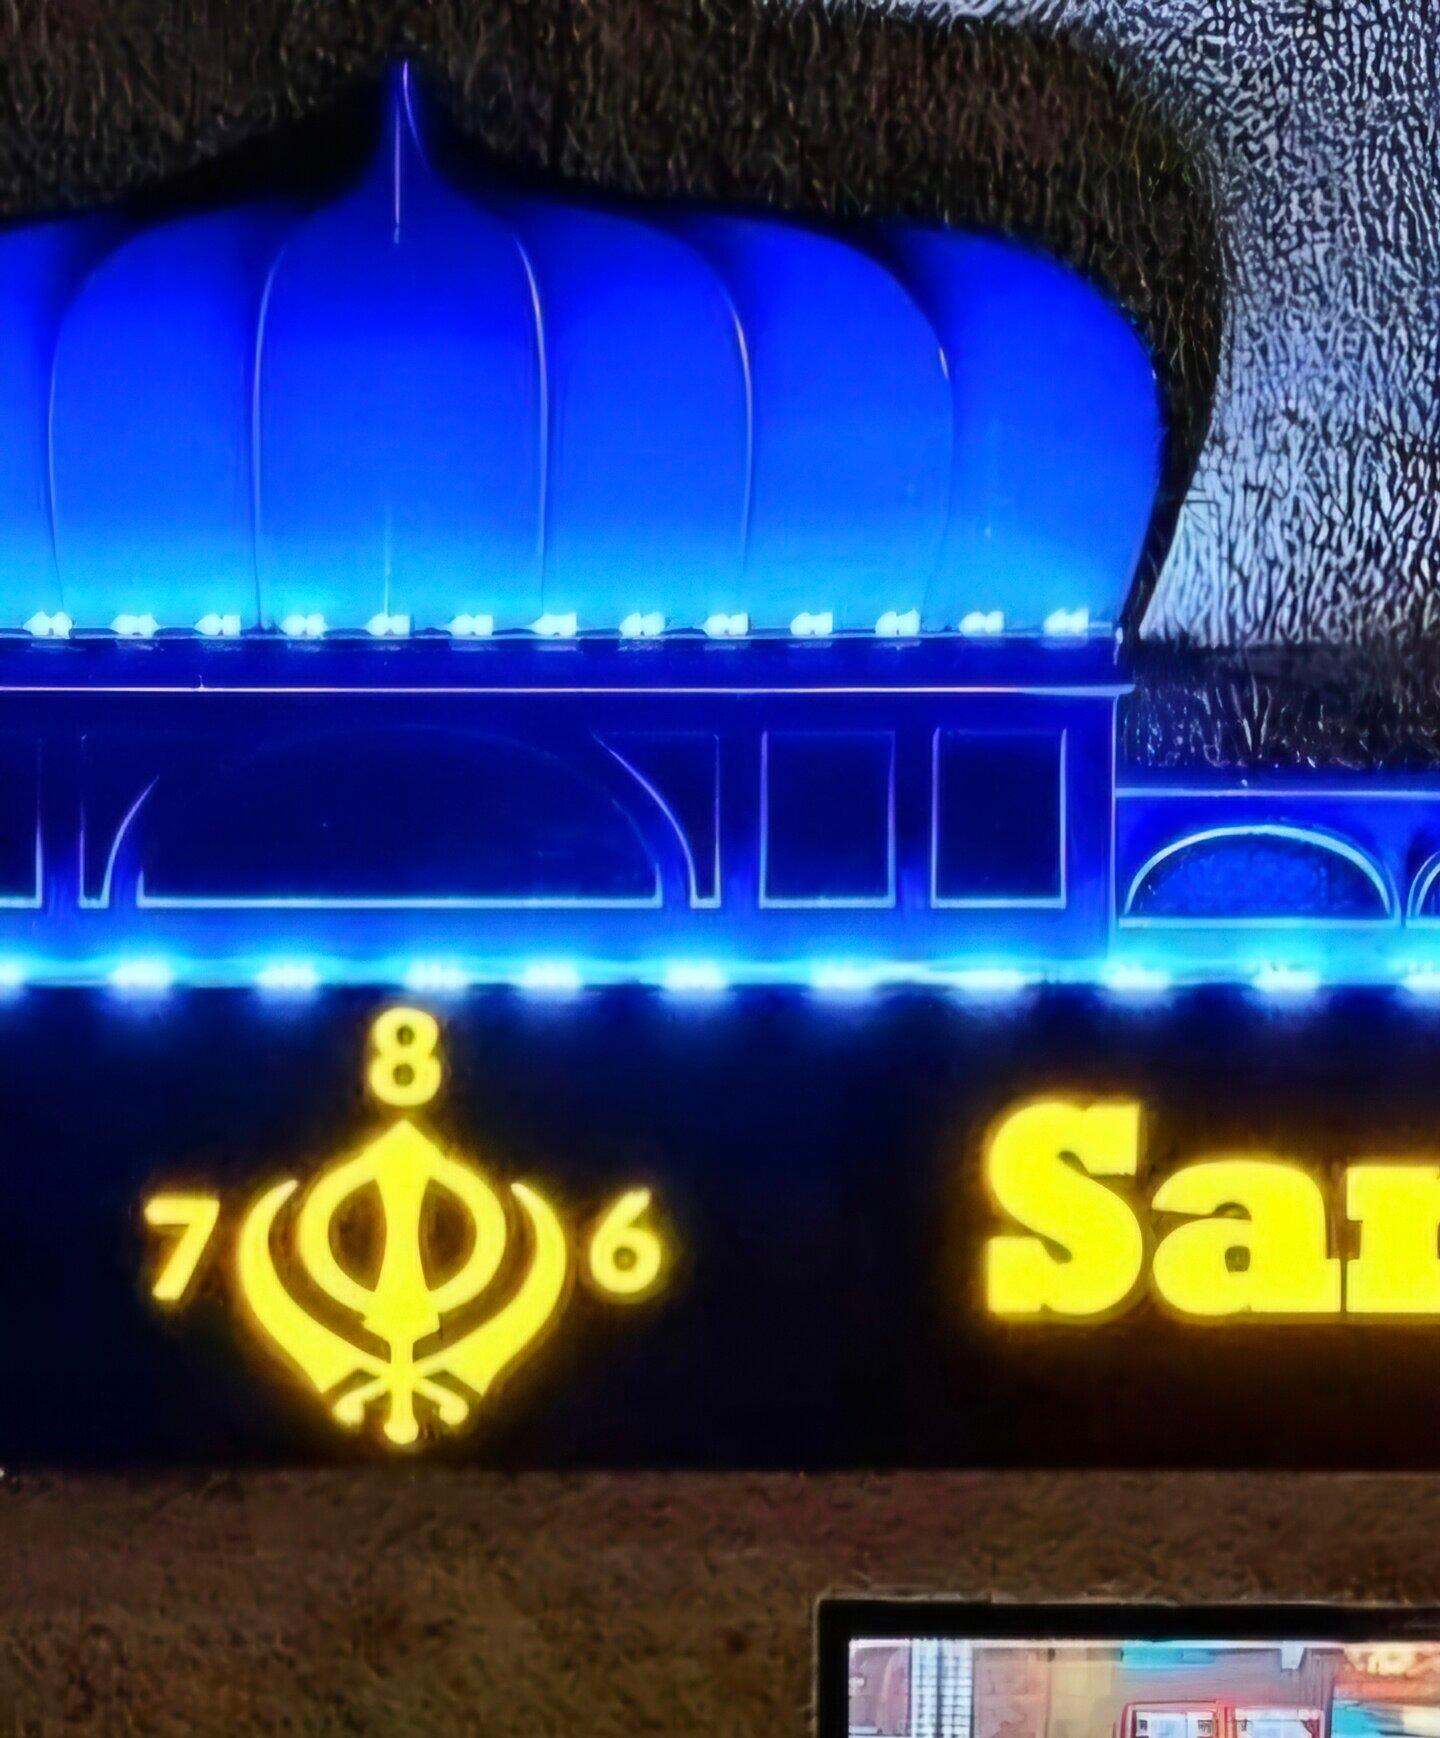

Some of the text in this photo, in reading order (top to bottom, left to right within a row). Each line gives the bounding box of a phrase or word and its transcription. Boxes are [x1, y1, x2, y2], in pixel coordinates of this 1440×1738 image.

[367, 1007, 441, 1106] 8
[144, 1198, 220, 1300] 7
[589, 1188, 663, 1293] 6
